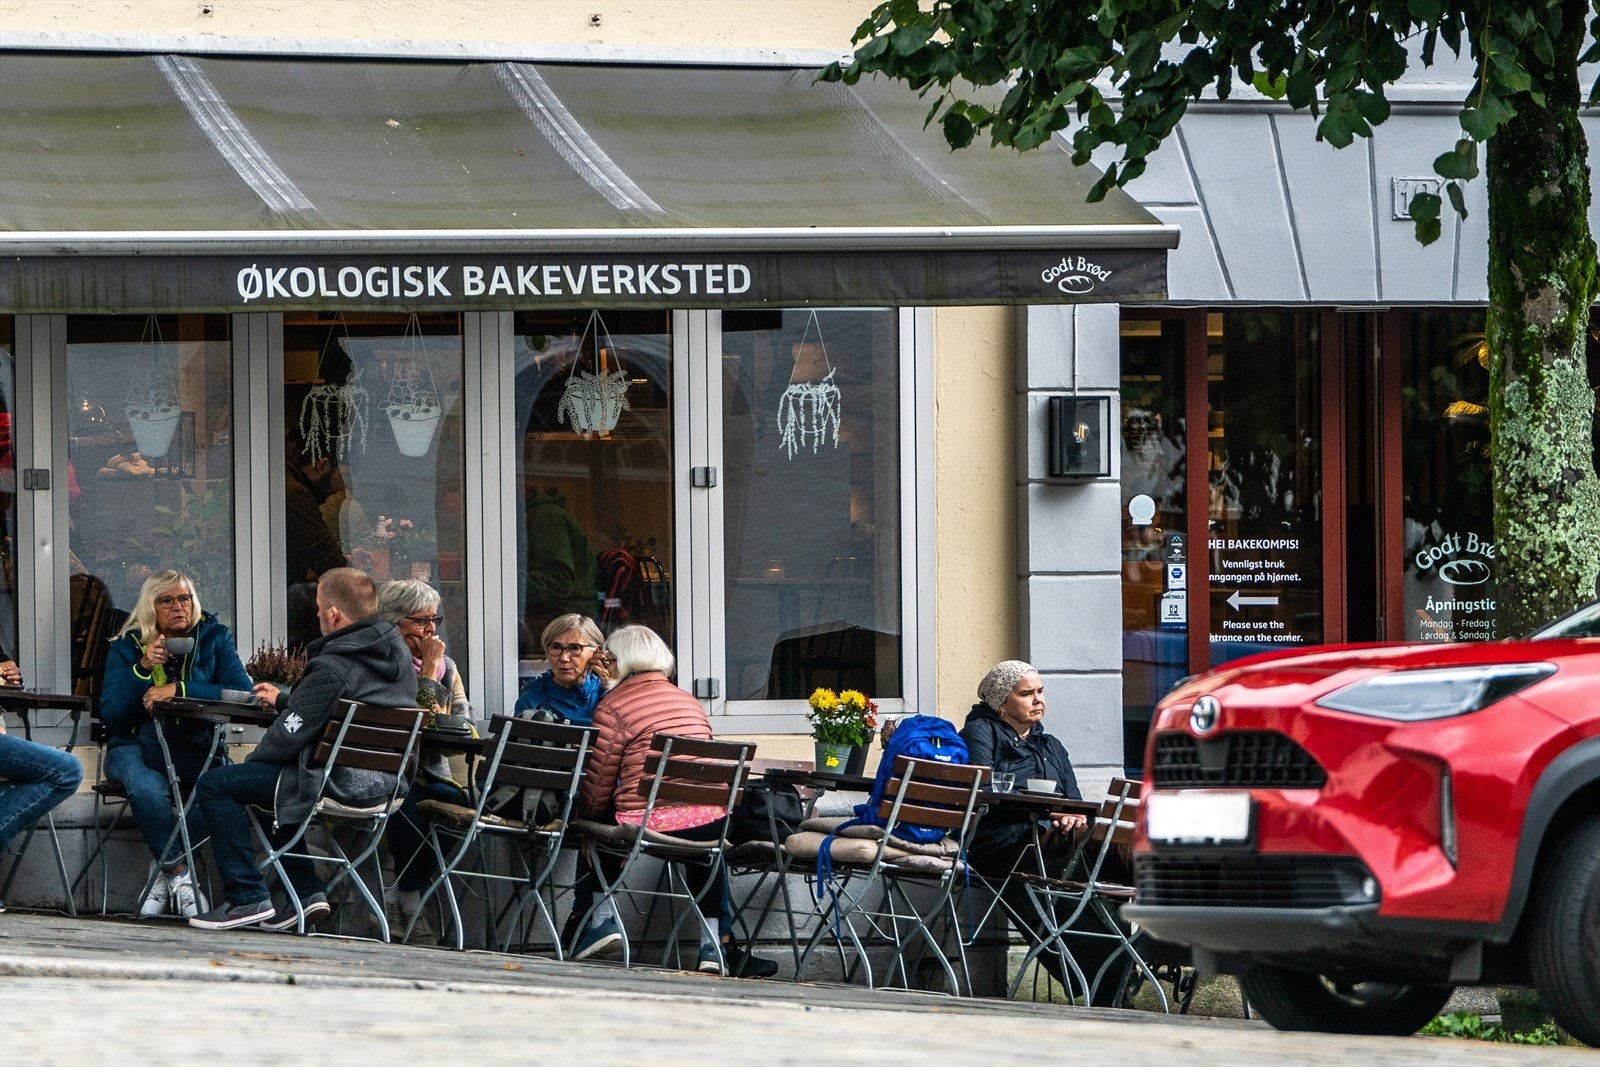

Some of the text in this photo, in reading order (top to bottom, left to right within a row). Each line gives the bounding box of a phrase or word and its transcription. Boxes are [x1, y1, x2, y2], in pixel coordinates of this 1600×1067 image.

[1041, 256, 1112, 283] Godt Brød
[236, 263, 751, 303] ØKOLOGISK BAKEVERKSTED
[1208, 539, 1299, 549] HEI BAKEKOMPIS!
[1415, 531, 1496, 570] Godt Brø
[1222, 560, 1285, 571] Vennligst bruk
[1208, 572, 1302, 583] nngangen på hjørnet.
[1223, 620, 1251, 629] Please
[1269, 620, 1285, 629] the
[1420, 619, 1454, 629] Mandag
[1461, 619, 1490, 629] Fredag
[1209, 632, 1304, 642] ntrance on the corner.
[1420, 631, 1449, 641] Lørdag
[1451, 631, 1457, 640] &
[1459, 631, 1490, 642] Søndag
